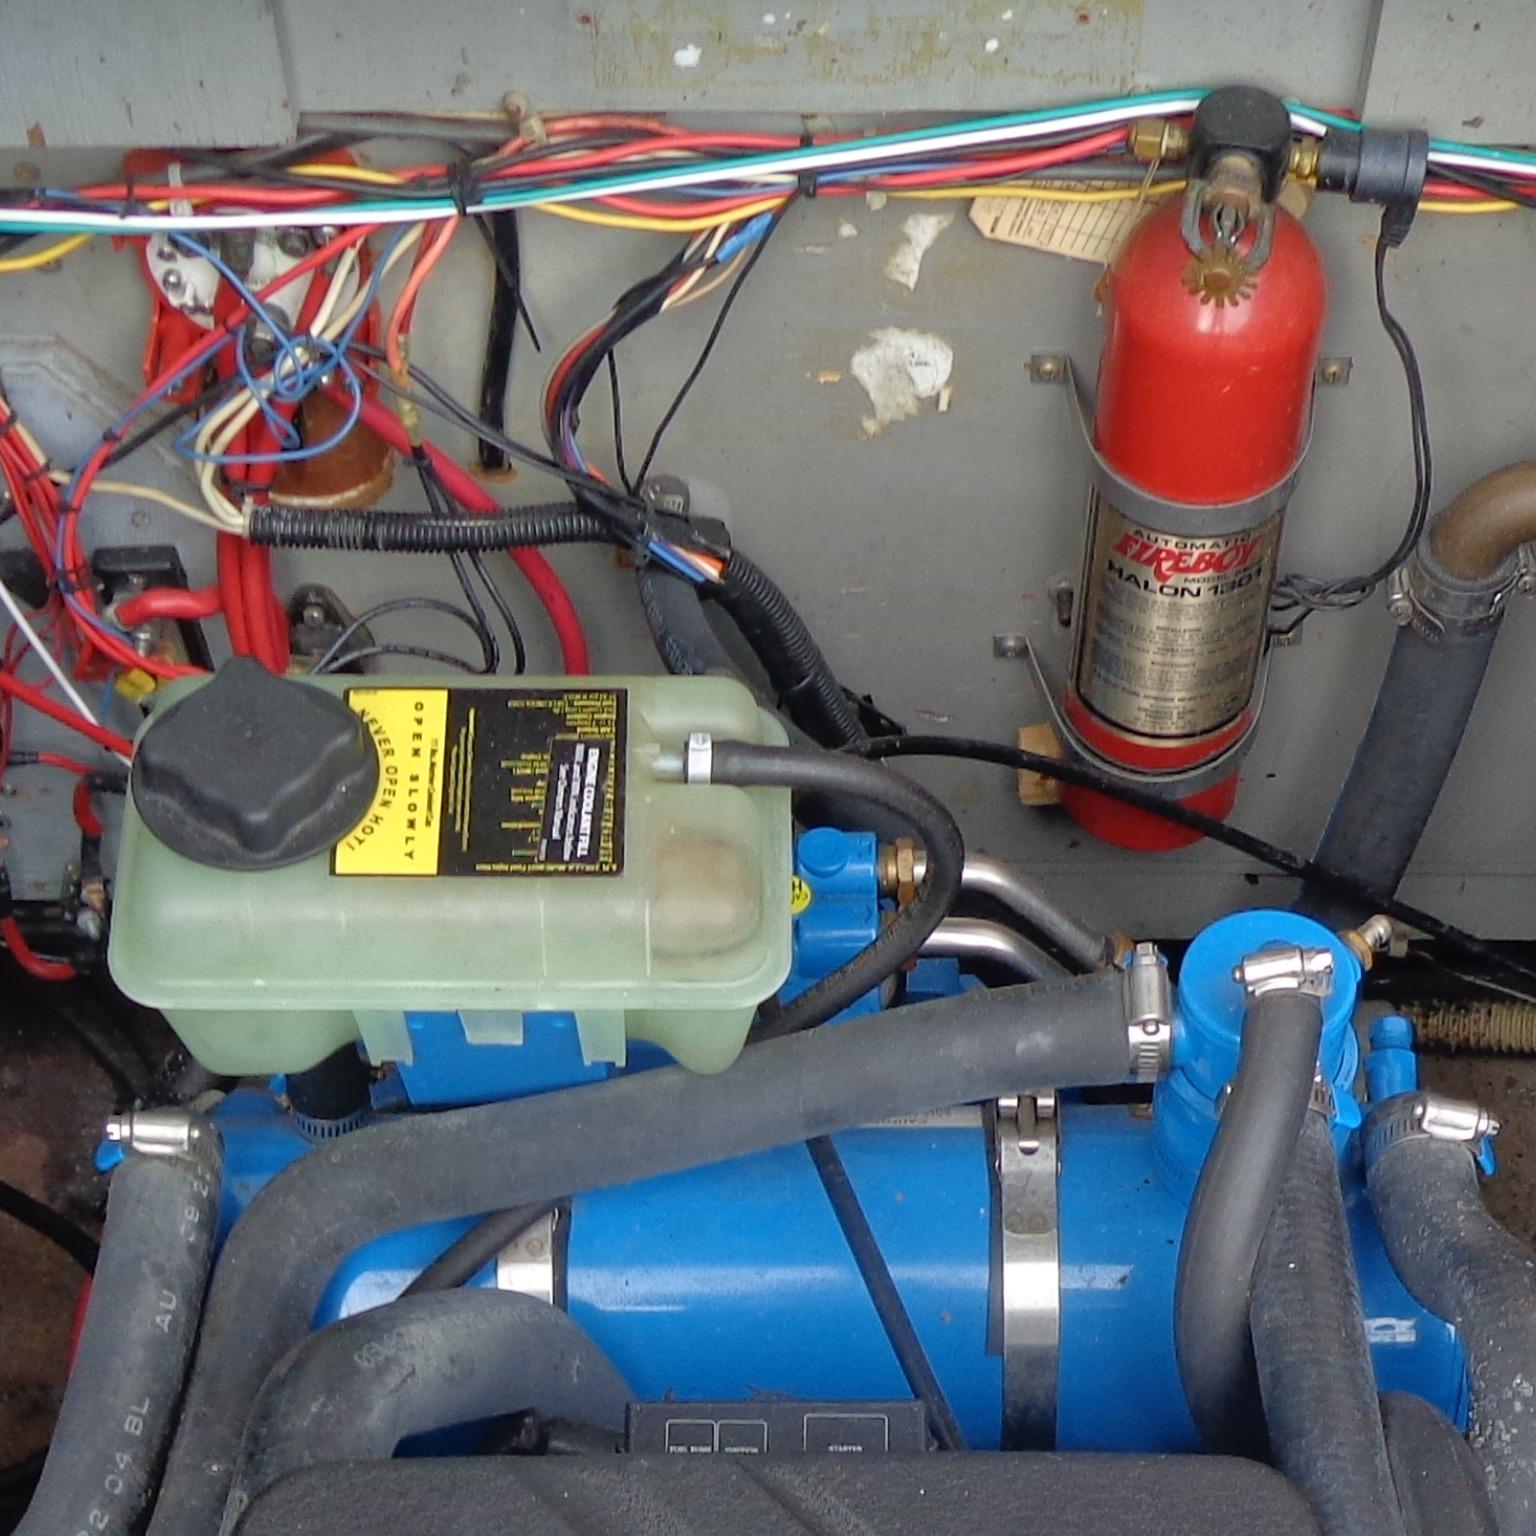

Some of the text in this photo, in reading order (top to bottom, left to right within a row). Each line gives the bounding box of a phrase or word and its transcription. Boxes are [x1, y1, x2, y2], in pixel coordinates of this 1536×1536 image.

[1113, 532, 1263, 582] FIREBOY
[1133, 528, 1252, 549] AUTOMATIC
[1107, 560, 1263, 597] HALON 1301
[358, 708, 395, 758] NEVER
[379, 765, 398, 808] OPEN
[404, 701, 424, 860] OPEN SLOWLY
[104, 1451, 133, 1494] 04
[124, 1398, 149, 1435] BL
